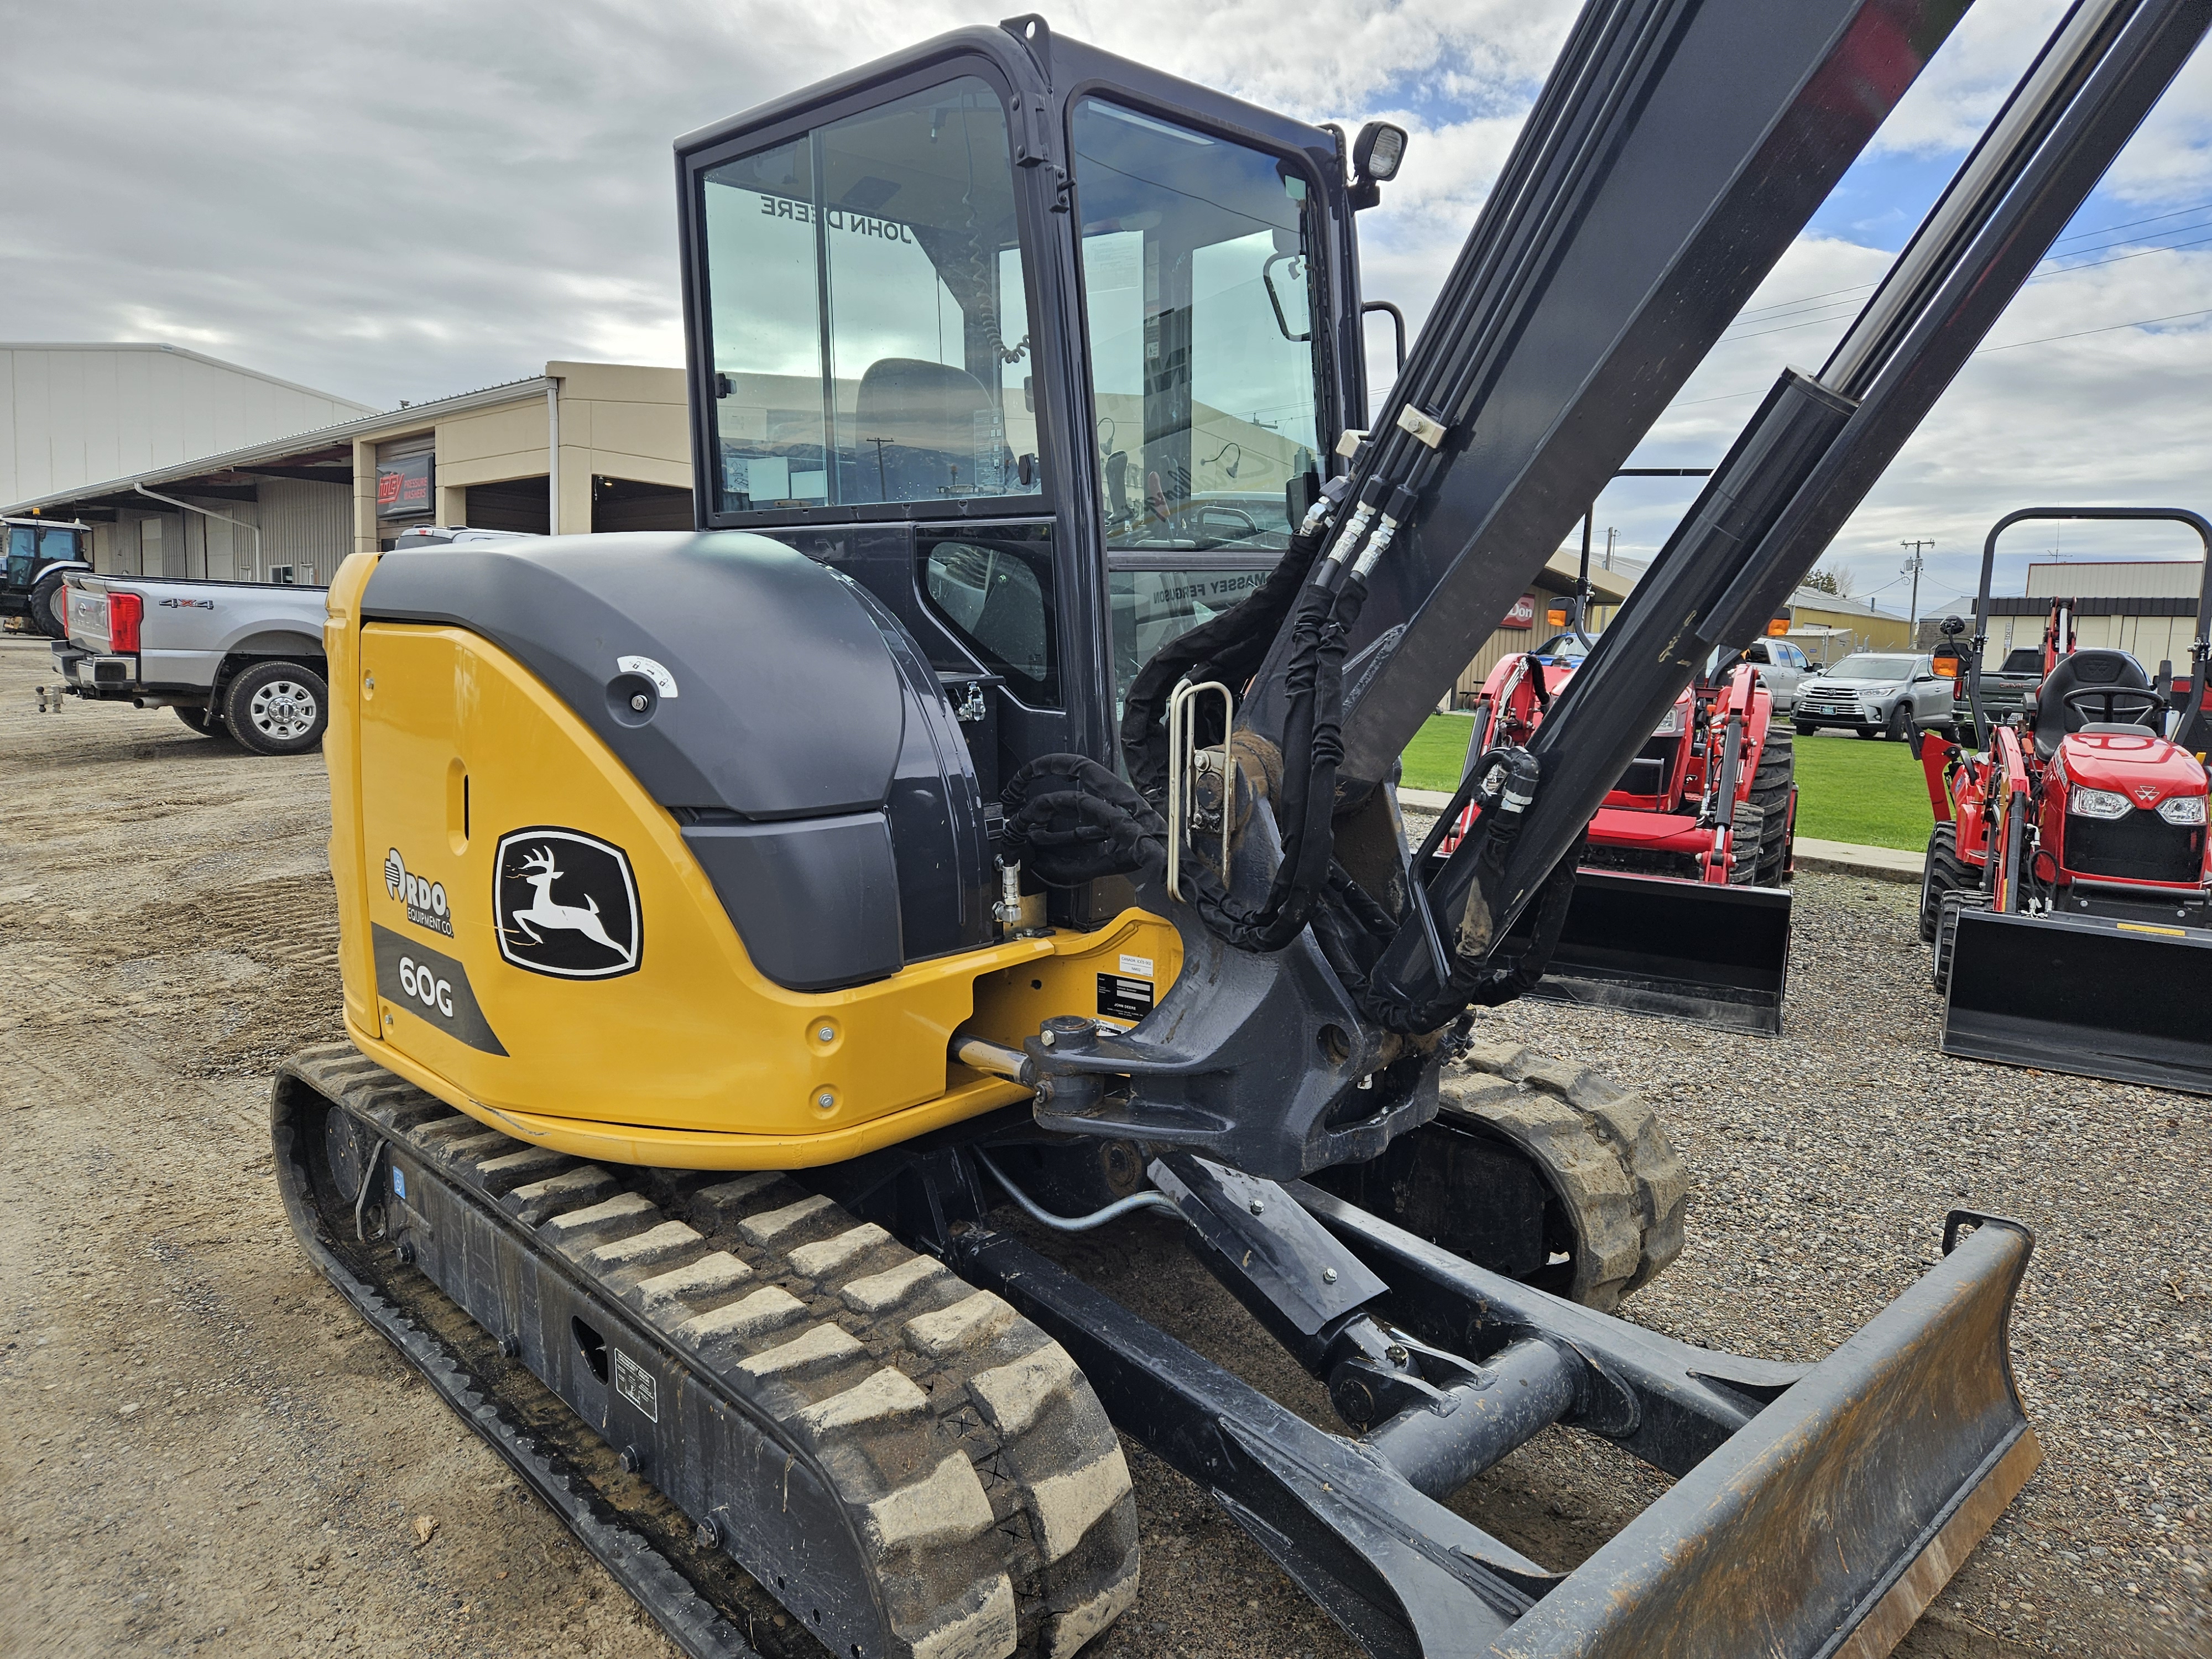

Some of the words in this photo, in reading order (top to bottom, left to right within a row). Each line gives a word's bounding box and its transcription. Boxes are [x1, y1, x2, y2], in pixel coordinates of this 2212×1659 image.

[408, 907, 441, 931] EQUIPMENT
[441, 920, 453, 936] CO.
[399, 957, 453, 1018] 60G
